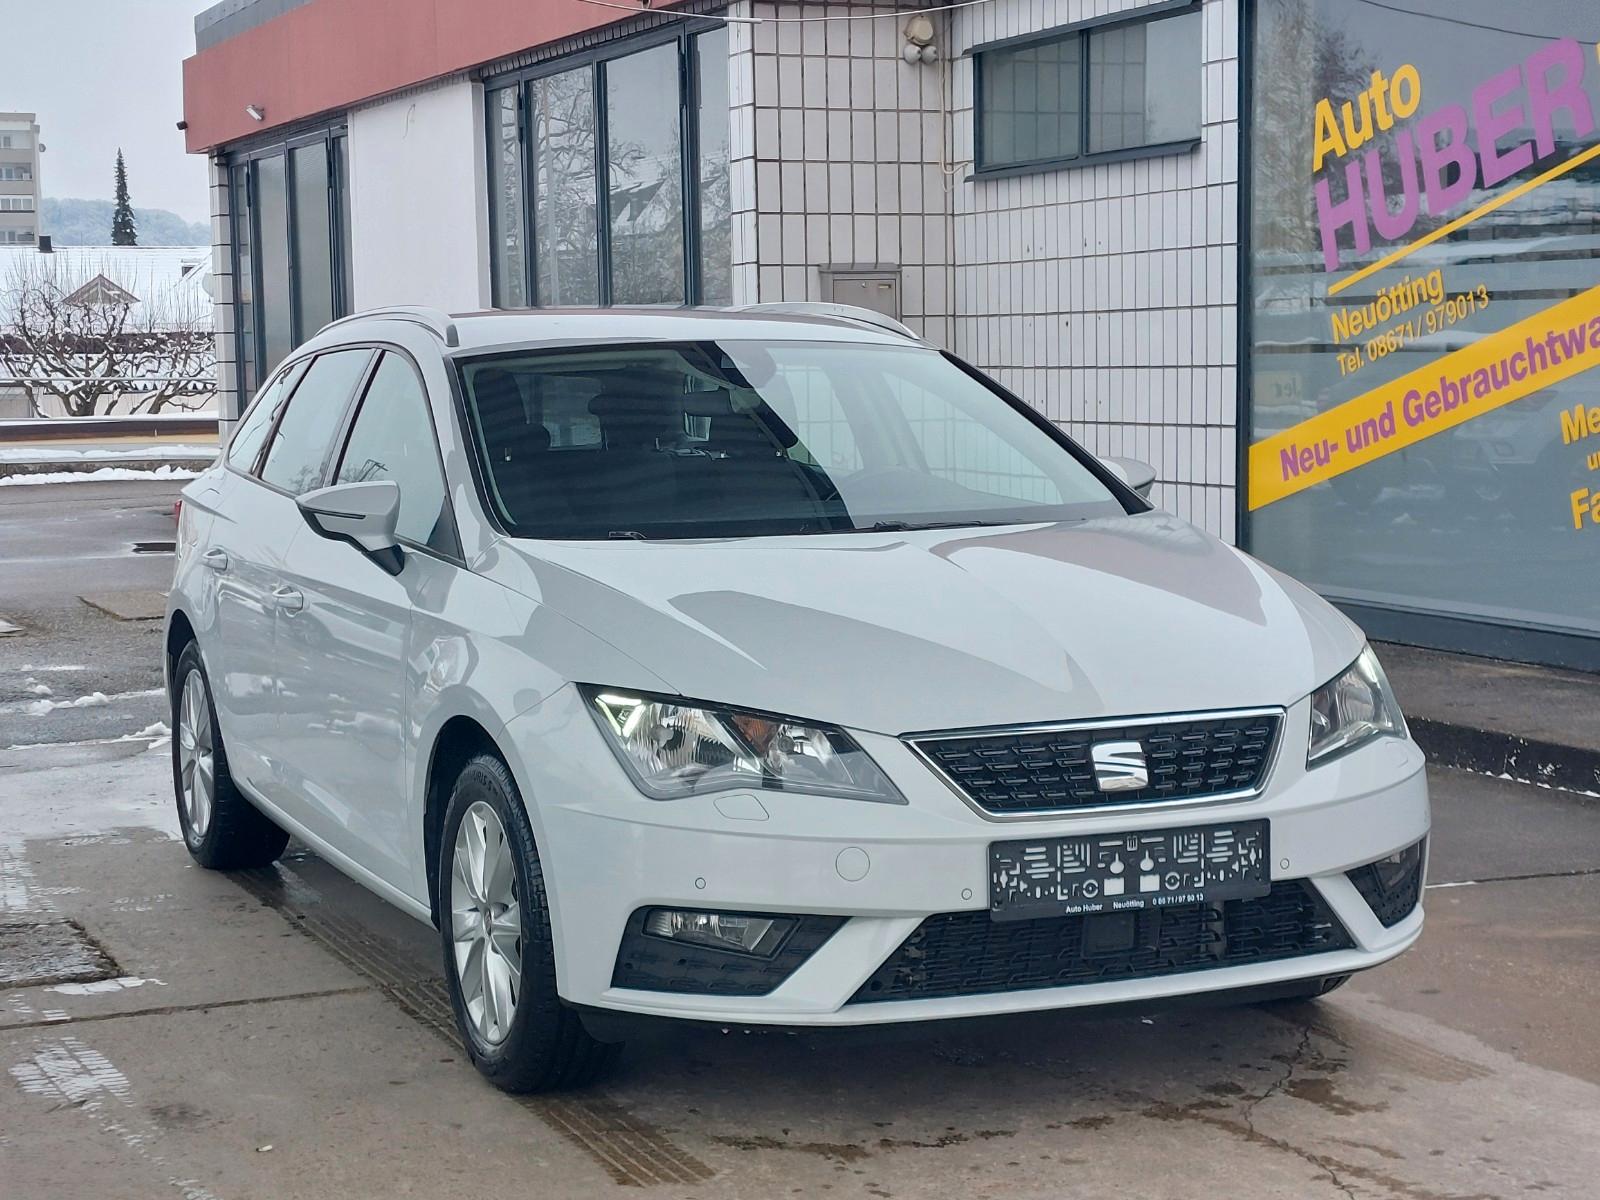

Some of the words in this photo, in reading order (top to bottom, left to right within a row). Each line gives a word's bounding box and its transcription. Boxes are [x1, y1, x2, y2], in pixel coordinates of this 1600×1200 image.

[1312, 64, 1421, 173] Auto
[1314, 36, 1595, 273] HUBER
[1331, 269, 1445, 345] Neuötting
[1280, 439, 1339, 481] Neu-
[1345, 401, 1397, 453] und
[1402, 316, 1600, 427] Gebrauchtwa
[1336, 346, 1365, 376] Tel.
[1065, 905, 1082, 914] Auto
[1083, 903, 1103, 912] Huber
